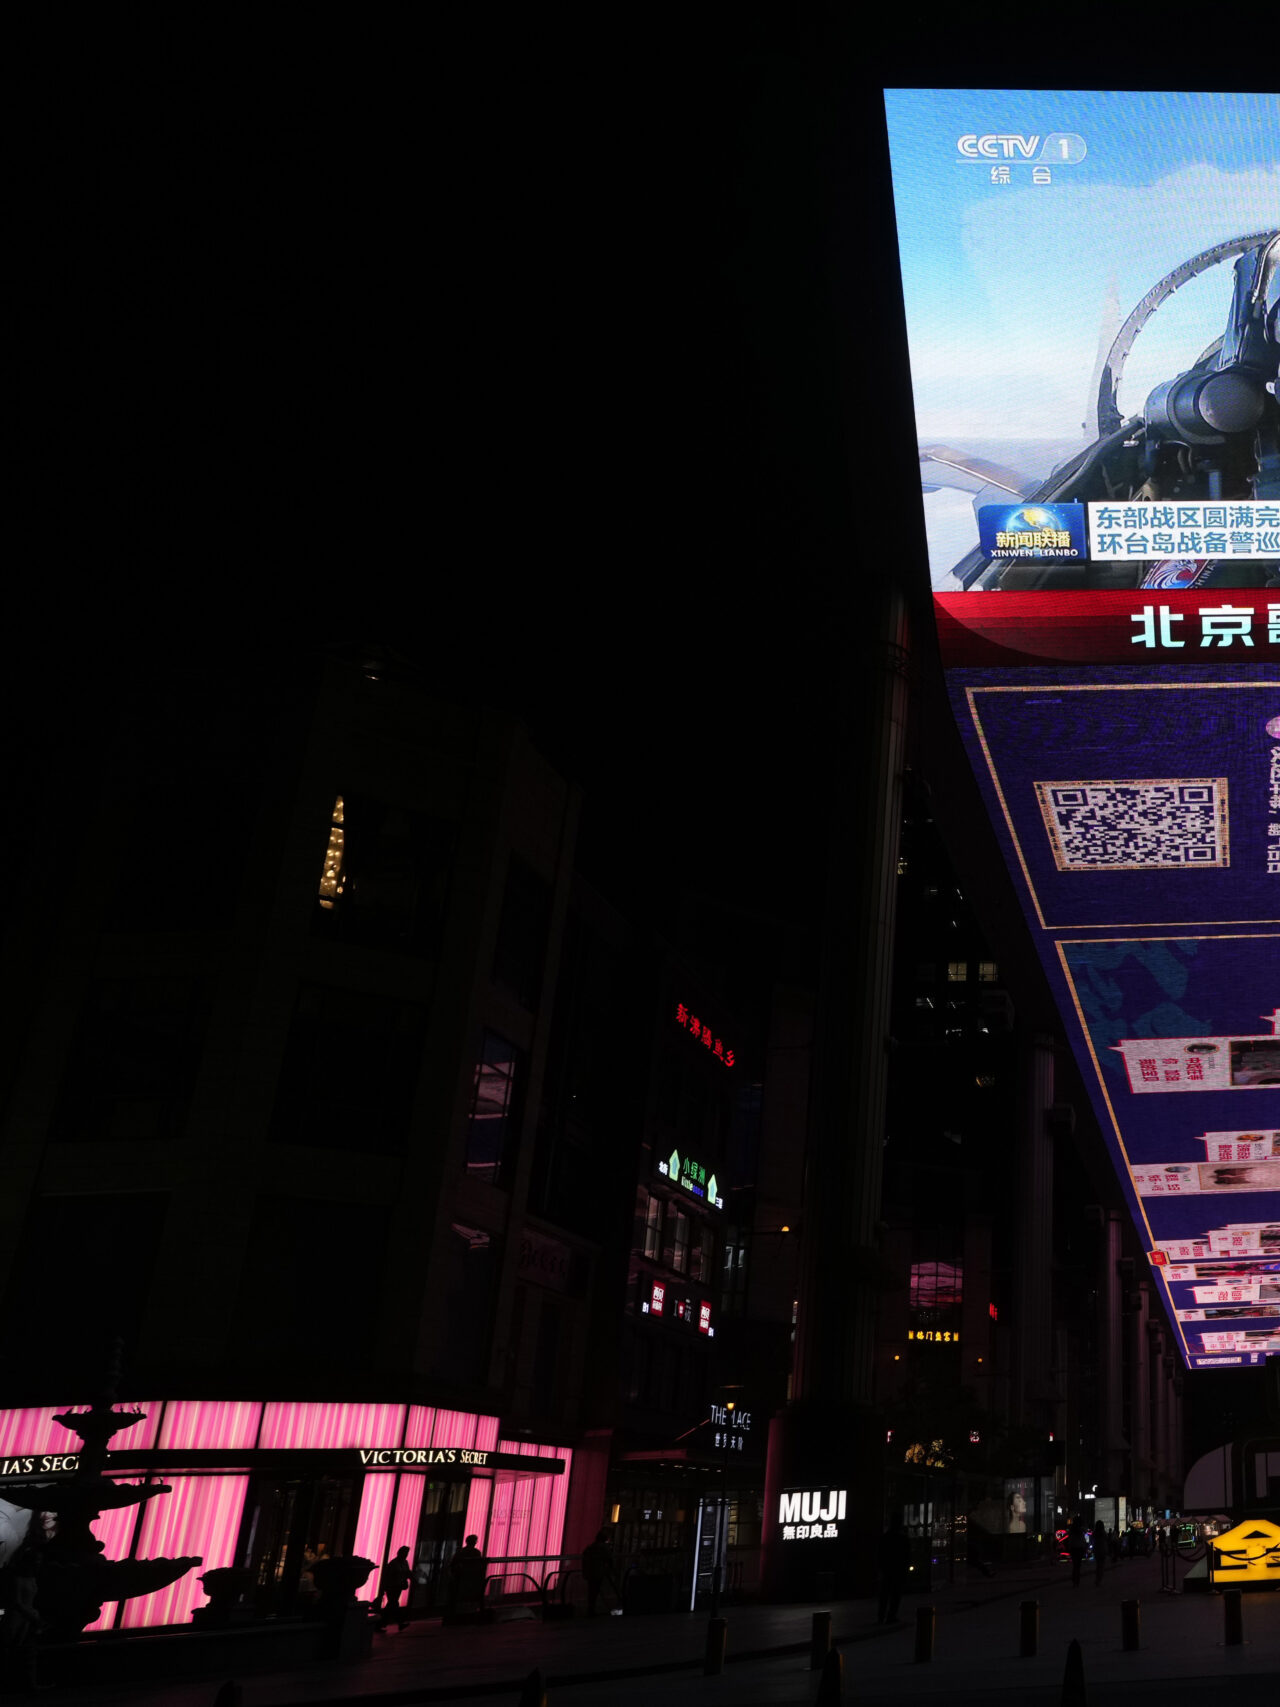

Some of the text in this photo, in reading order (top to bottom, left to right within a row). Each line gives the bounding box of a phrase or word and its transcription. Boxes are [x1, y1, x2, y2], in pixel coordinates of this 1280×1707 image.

[957, 134, 1069, 159] CCTV 1
[990, 165, 1051, 185] 综合
[996, 530, 1071, 549] 新闻联播
[991, 548, 1079, 558] XINWEN LIANBO
[711, 1405, 727, 1426] THE
[360, 1449, 488, 1465] VICTORIA'S SECRET
[778, 1490, 847, 1524] MUJI
[782, 1523, 838, 1541] 無印良品
